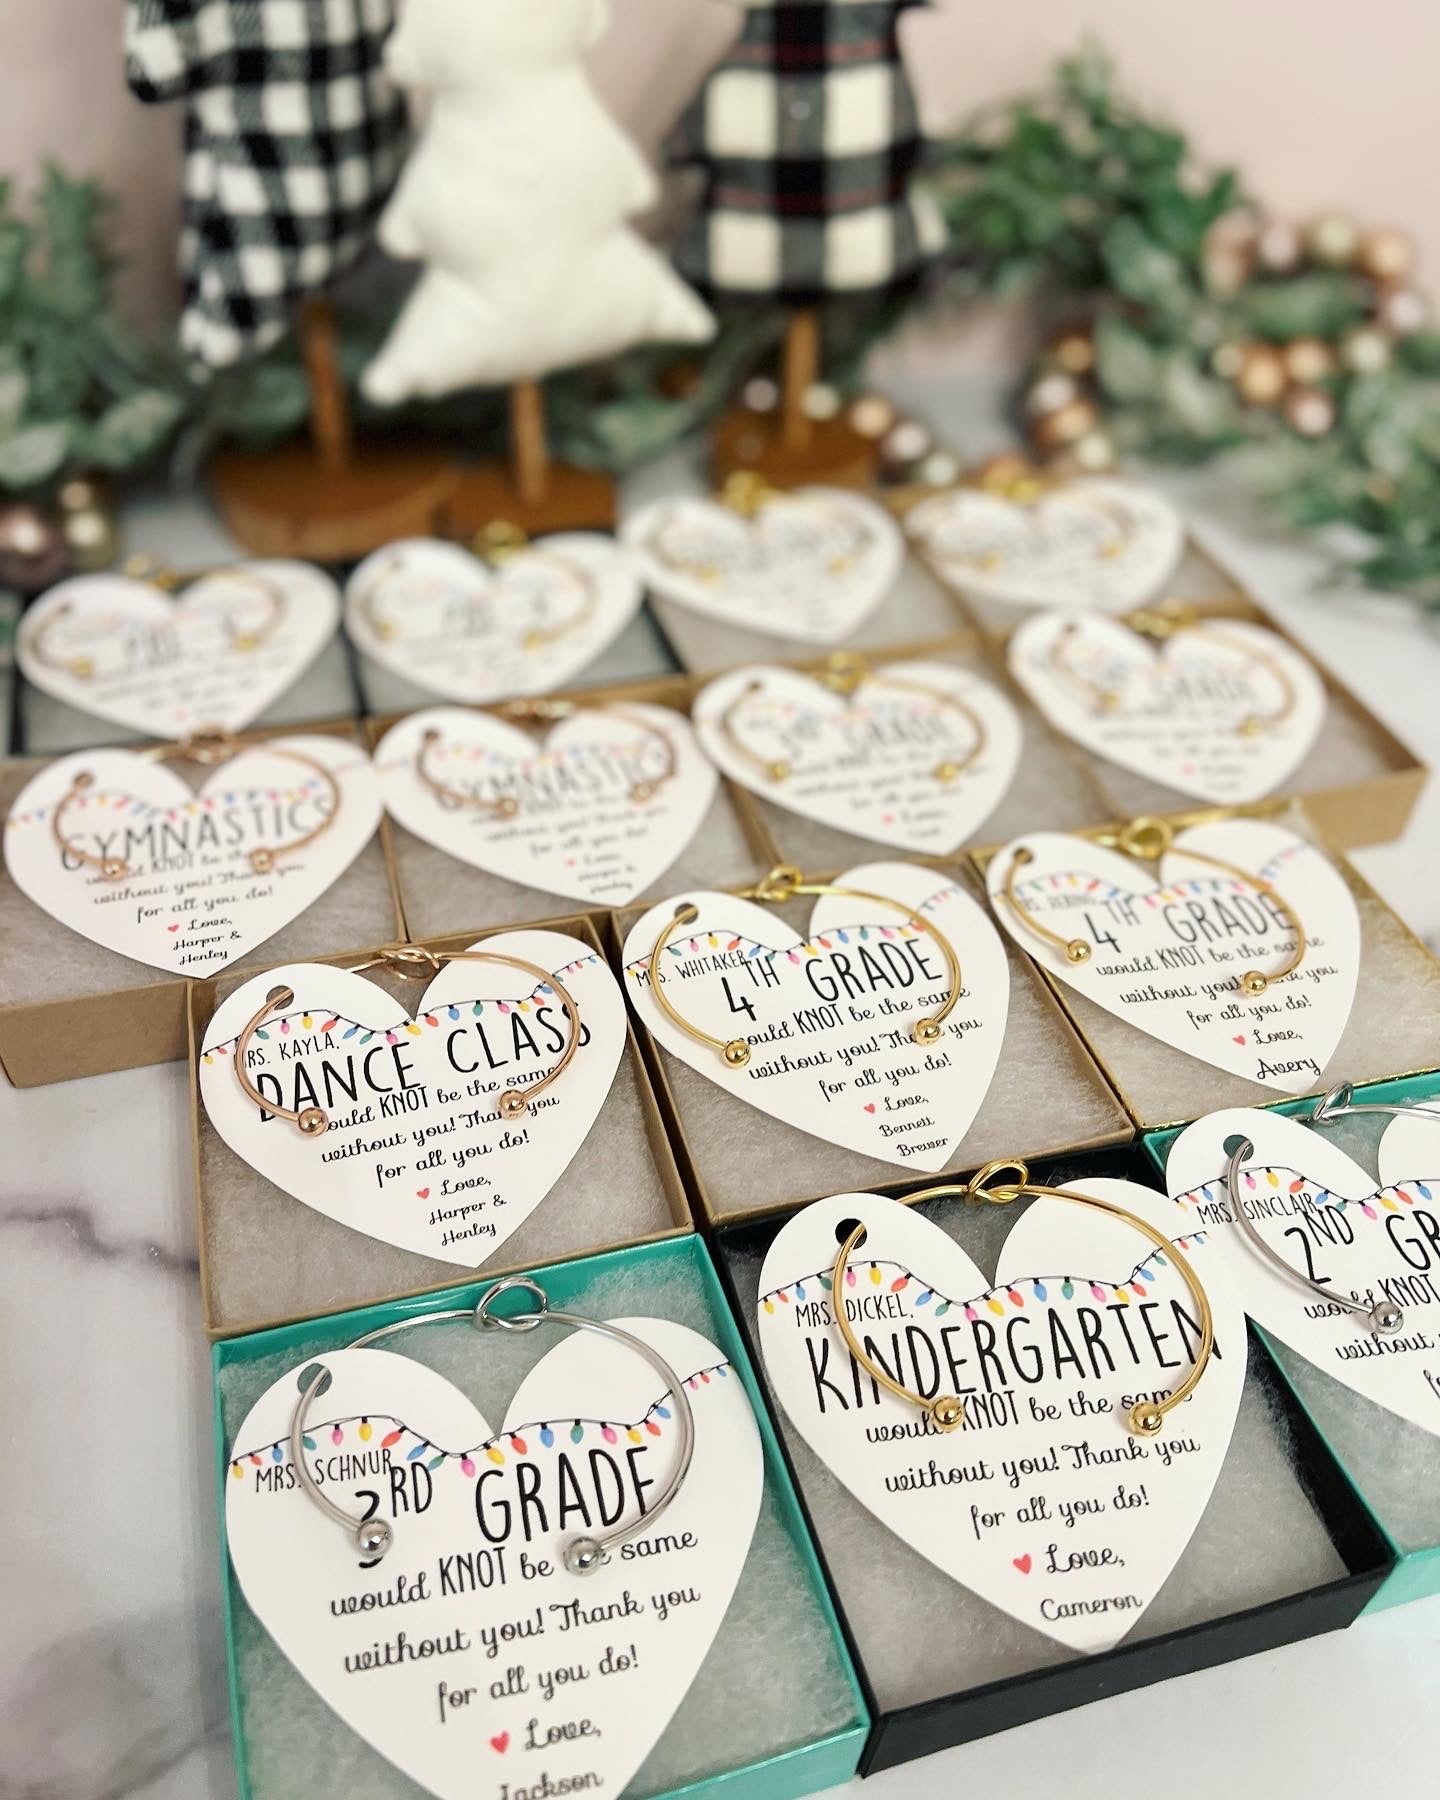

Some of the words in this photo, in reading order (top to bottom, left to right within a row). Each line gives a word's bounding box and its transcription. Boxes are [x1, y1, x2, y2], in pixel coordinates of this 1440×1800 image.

[137, 905, 164, 924] for
[171, 898, 200, 914] all
[1162, 891, 1295, 943] GRADE
[173, 934, 225, 951] Harper
[230, 930, 243, 940] &
[179, 949, 229, 966] Henley
[804, 938, 943, 1002] GRADE
[1096, 956, 1159, 977] would
[1155, 944, 1205, 970] KNOT
[1208, 947, 1233, 963] be
[1237, 943, 1270, 959] the
[1119, 985, 1197, 1004] without
[1306, 965, 1339, 984] you
[793, 1003, 845, 1035] KNOT
[848, 1005, 876, 1022] be
[878, 997, 913, 1015] the
[1187, 1009, 1213, 1031] for
[1220, 1003, 1246, 1021] all
[1249, 1003, 1283, 1022] you
[1285, 994, 1313, 1011] do!
[748, 1049, 833, 1080] without
[837, 1035, 882, 1067] you!
[948, 1017, 983, 1040] you
[255, 1041, 422, 1123] DANCE
[818, 1078, 848, 1103] for
[854, 1068, 882, 1088] all
[884, 1064, 920, 1087] you
[924, 1052, 953, 1071] do!
[1256, 1056, 1321, 1080] Avery
[325, 1105, 376, 1133] ould
[378, 1086, 429, 1119] KNOT
[436, 1088, 462, 1104] be
[466, 1079, 501, 1098] the
[883, 1093, 930, 1112] Love,
[321, 1133, 407, 1164] without
[412, 1116, 457, 1147] you!
[527, 1096, 560, 1117] you
[896, 1137, 950, 1158] Brewer
[376, 1163, 407, 1188] for
[415, 1149, 447, 1172] all
[452, 1145, 493, 1168] you
[498, 1128, 531, 1151] do!
[440, 1175, 492, 1196] Love,
[428, 1201, 487, 1225] Harper
[493, 1194, 508, 1207] &
[1196, 1202, 1240, 1227] MRS.
[441, 1222, 497, 1247] Henley
[1284, 1203, 1355, 1285] 2ND
[1377, 1273, 1440, 1308] KNOT
[796, 1301, 838, 1328] MRS.
[845, 1293, 914, 1322] DICKEL,
[805, 1299, 1223, 1414] KINDERGARTEN
[1335, 1331, 1435, 1360] without
[961, 1389, 1020, 1432] KNOT
[1028, 1396, 1062, 1423] be
[1068, 1390, 1114, 1417] the
[255, 1463, 303, 1493] MRS.
[884, 1458, 995, 1494] without
[1001, 1446, 1060, 1489] you!
[1060, 1436, 1150, 1470] Thank
[1153, 1435, 1202, 1467] you
[969, 1503, 1006, 1542] for
[1016, 1495, 1053, 1525] all
[1057, 1494, 1106, 1529] you
[1112, 1483, 1151, 1511] do!
[330, 1570, 431, 1617] would
[438, 1546, 507, 1596] KNOT
[519, 1552, 555, 1580] be
[620, 1531, 699, 1561] same
[1044, 1542, 1126, 1575] Love,
[1039, 1591, 1144, 1622] Cameron
[343, 1627, 471, 1674] without
[480, 1607, 546, 1659] you!
[549, 1590, 644, 1632] Thank
[651, 1586, 702, 1621] you
[437, 1680, 478, 1723] for
[489, 1665, 530, 1700] all
[537, 1661, 590, 1701] you
[599, 1643, 640, 1675] do!
[523, 1717, 602, 1751] Love,
